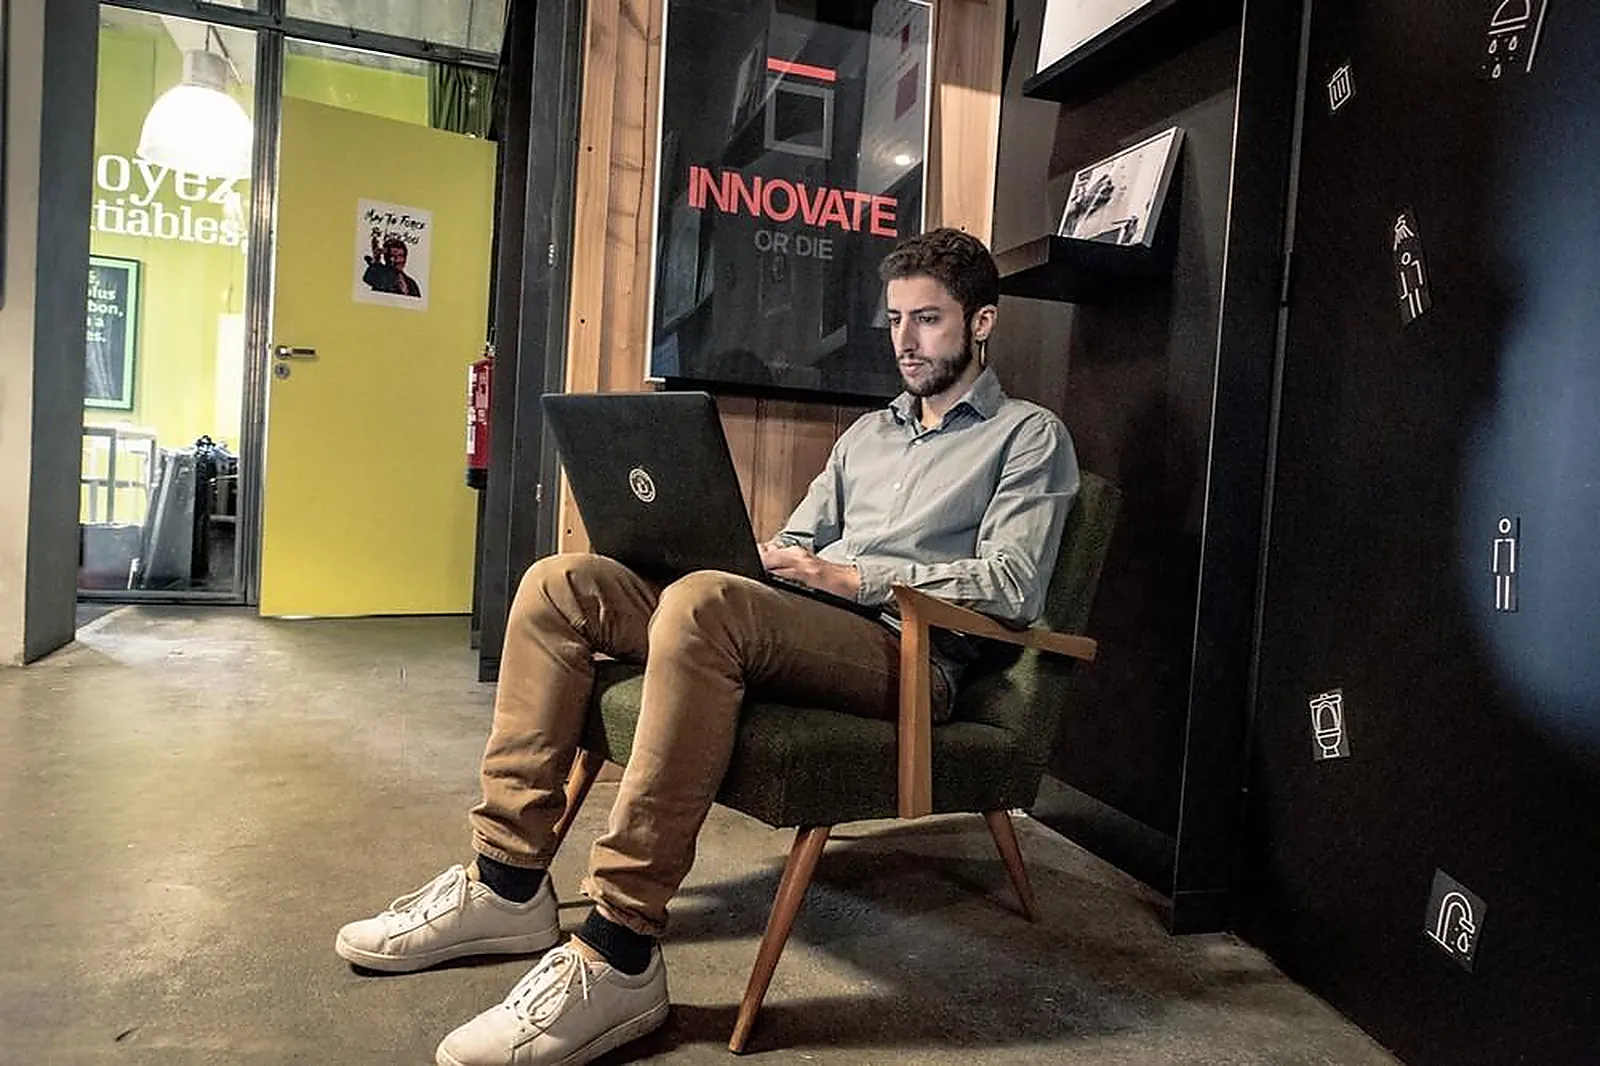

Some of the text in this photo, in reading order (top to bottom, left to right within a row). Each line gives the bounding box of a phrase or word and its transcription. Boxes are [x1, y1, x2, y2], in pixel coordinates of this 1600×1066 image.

[97, 154, 242, 206] oyez
[687, 165, 898, 238] INNOVATE
[90, 199, 249, 255] tiables,
[754, 230, 834, 260] OR DIE
